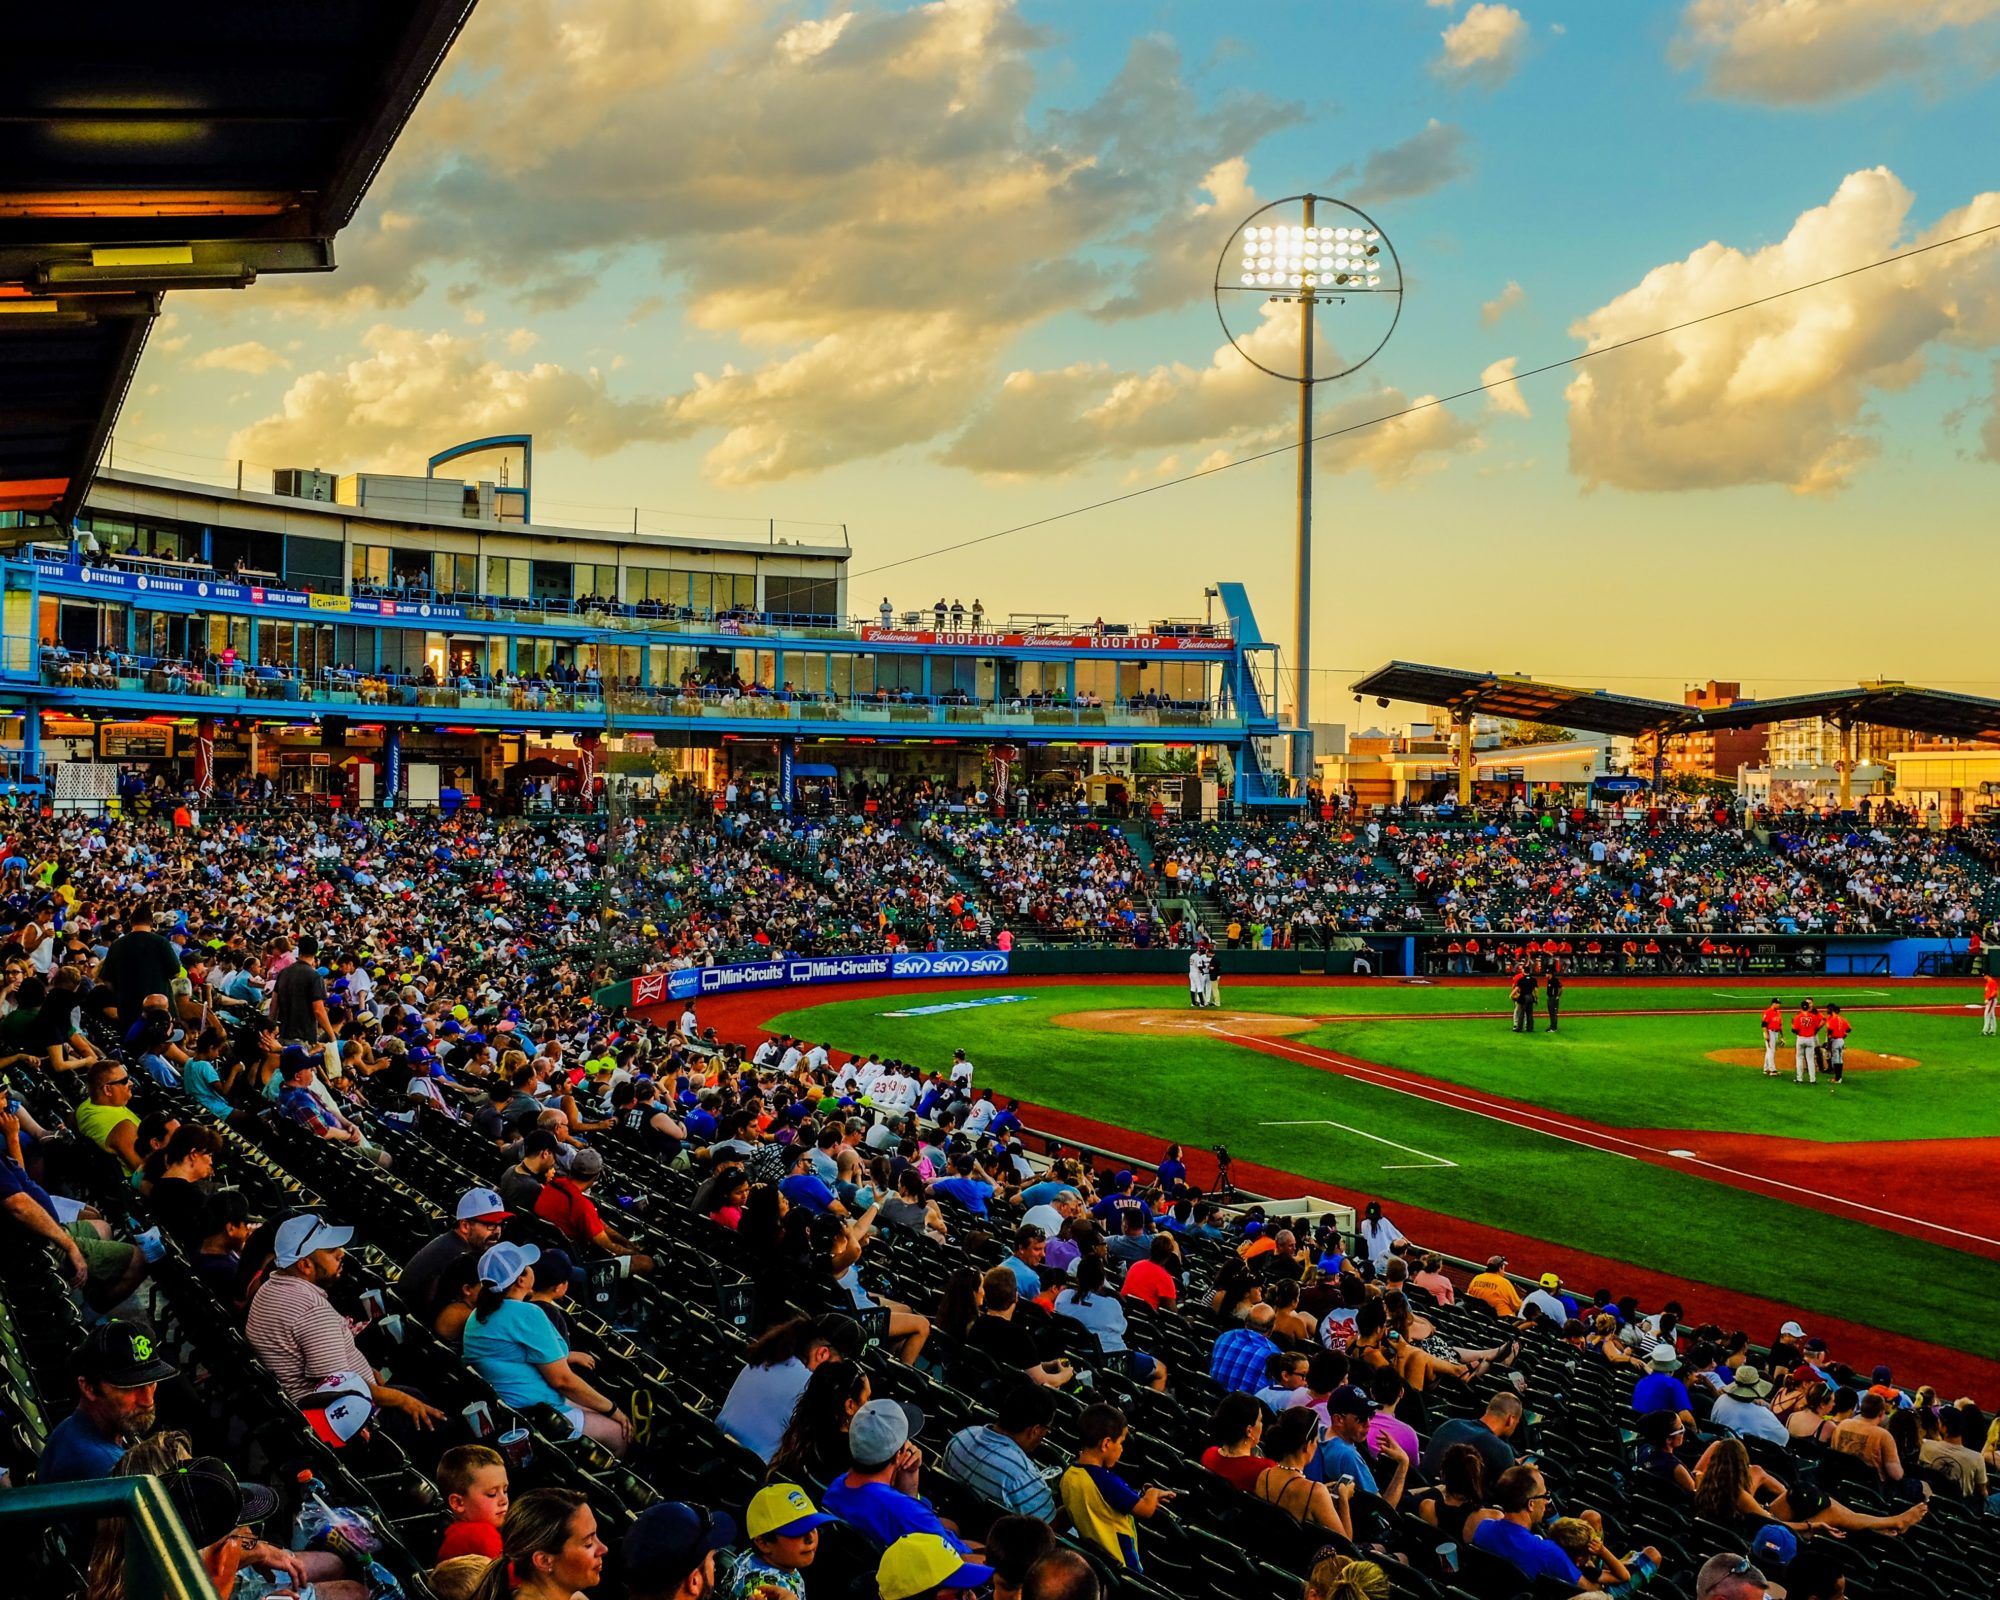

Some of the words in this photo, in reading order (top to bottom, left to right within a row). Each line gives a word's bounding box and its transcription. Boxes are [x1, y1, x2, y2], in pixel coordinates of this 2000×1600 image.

[91, 572, 125, 585] NEWCOMBE
[150, 579, 183, 592] ROBINSON
[215, 587, 240, 597] HODGES
[267, 593, 285, 602] WORLD
[286, 594, 307, 604] CHAMPS
[433, 608, 460, 617] SNIDER
[868, 630, 918, 641] Budweiser
[935, 633, 1005, 645] ROOFTOP
[1022, 636, 1073, 647] Budweiser
[1090, 638, 1160, 649] ROOFTOP
[1178, 638, 1229, 649] Budweiser
[114, 728, 168, 736] BULLPEN
[893, 961, 927, 974] SNY
[932, 961, 966, 973] SNY
[970, 960, 1004, 972] SNY
[874, 1082, 887, 1093] 23
[1113, 1199, 1141, 1209] CARTER
[1473, 1281, 1498, 1290] SECURITY
